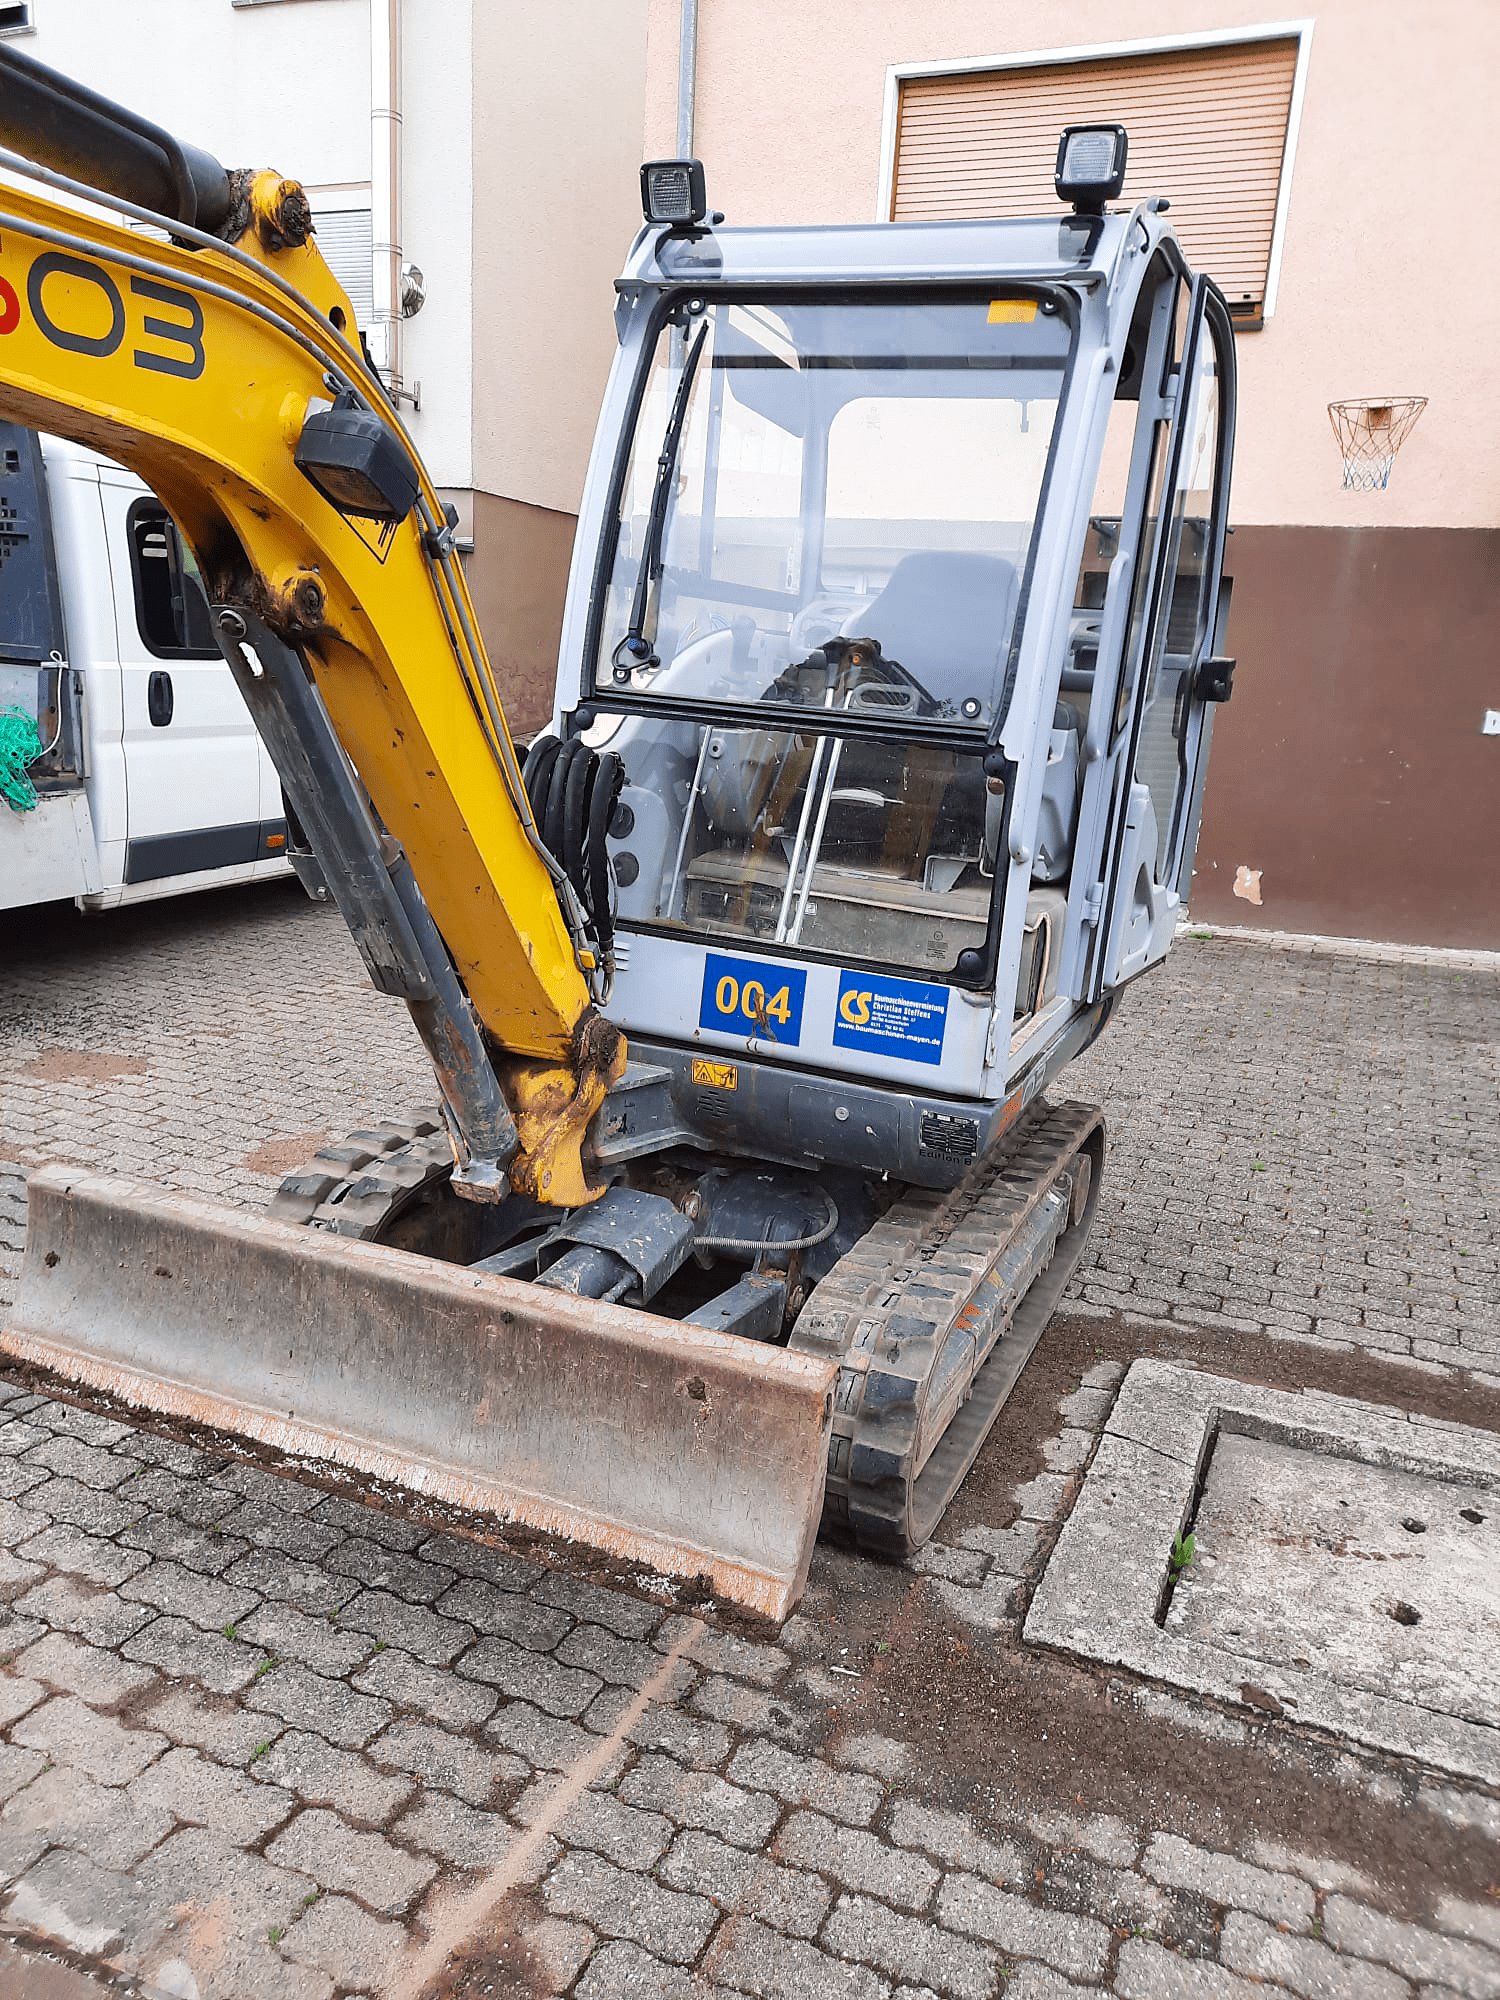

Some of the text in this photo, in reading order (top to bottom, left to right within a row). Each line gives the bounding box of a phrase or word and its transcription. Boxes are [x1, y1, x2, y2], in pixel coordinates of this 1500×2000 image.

[0, 233, 206, 381] 03
[715, 975, 792, 1025] 004
[840, 989, 873, 1025] CS
[873, 1001, 932, 1020] Christian Steffens
[874, 993, 945, 1015] Baumaschinenvermietung
[837, 1021, 941, 1046] www.baumaschinen-mayen.de
[919, 1149, 972, 1166] Edition B
